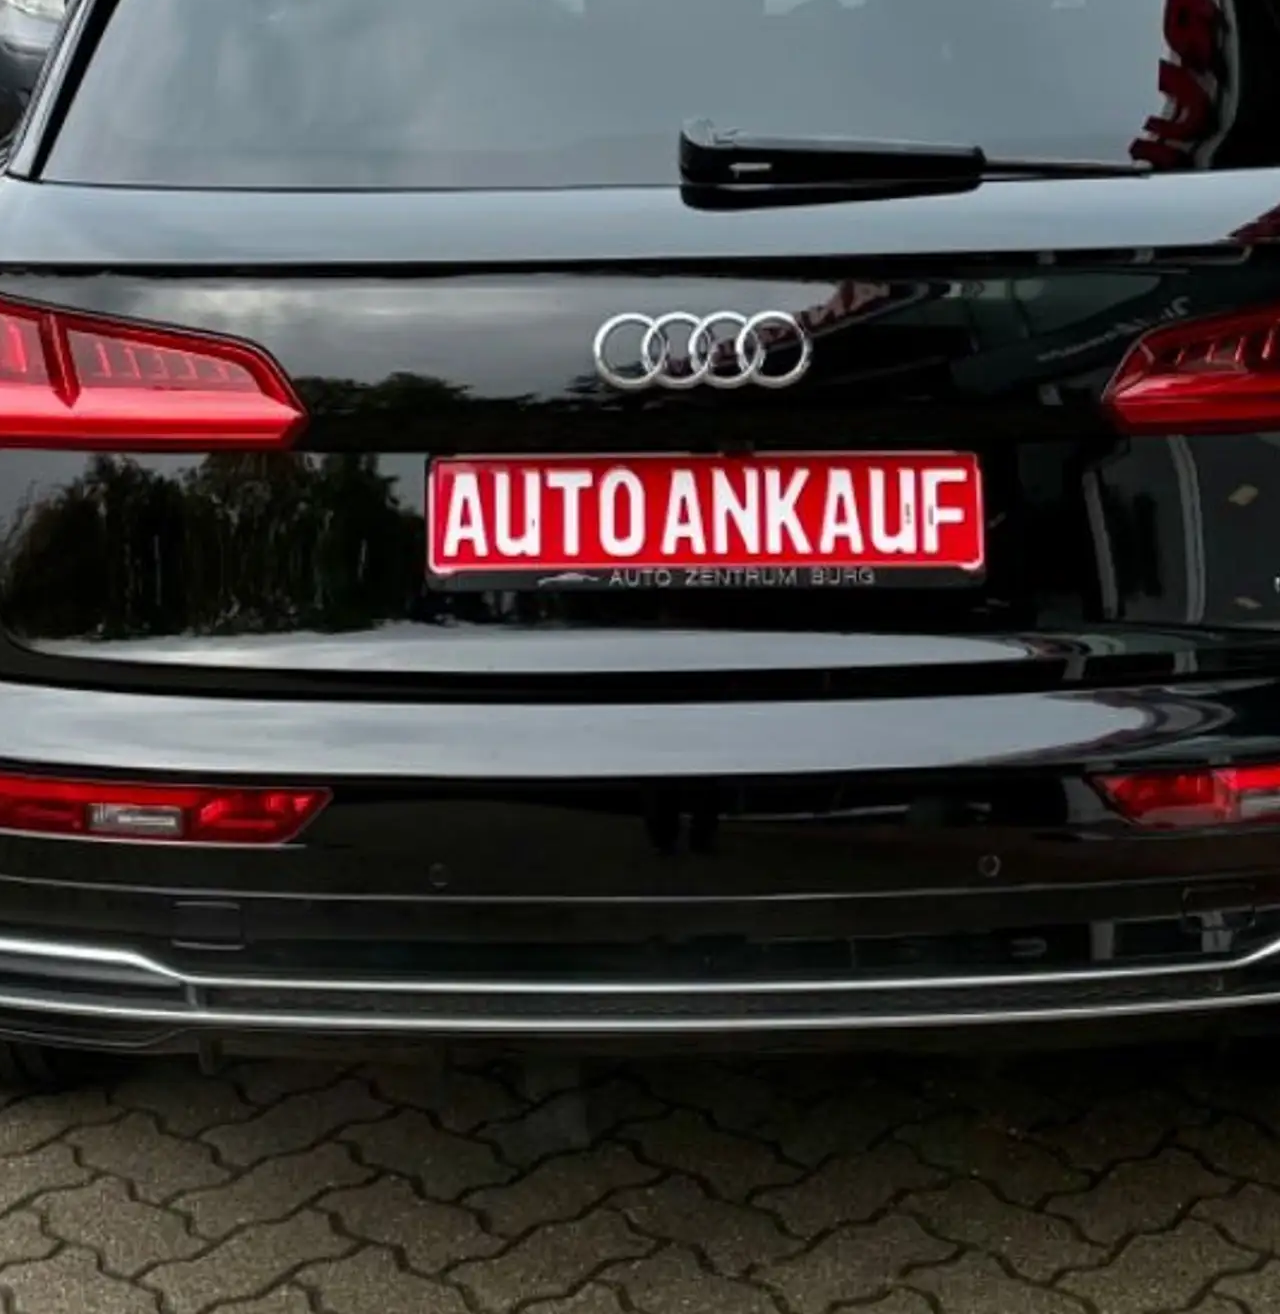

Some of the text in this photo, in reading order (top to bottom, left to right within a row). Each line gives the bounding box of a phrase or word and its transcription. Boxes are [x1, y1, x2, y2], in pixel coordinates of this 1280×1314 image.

[443, 467, 968, 557] AUTO ANKAUF
[609, 566, 876, 586] AUTO ZENTRUM BURG
